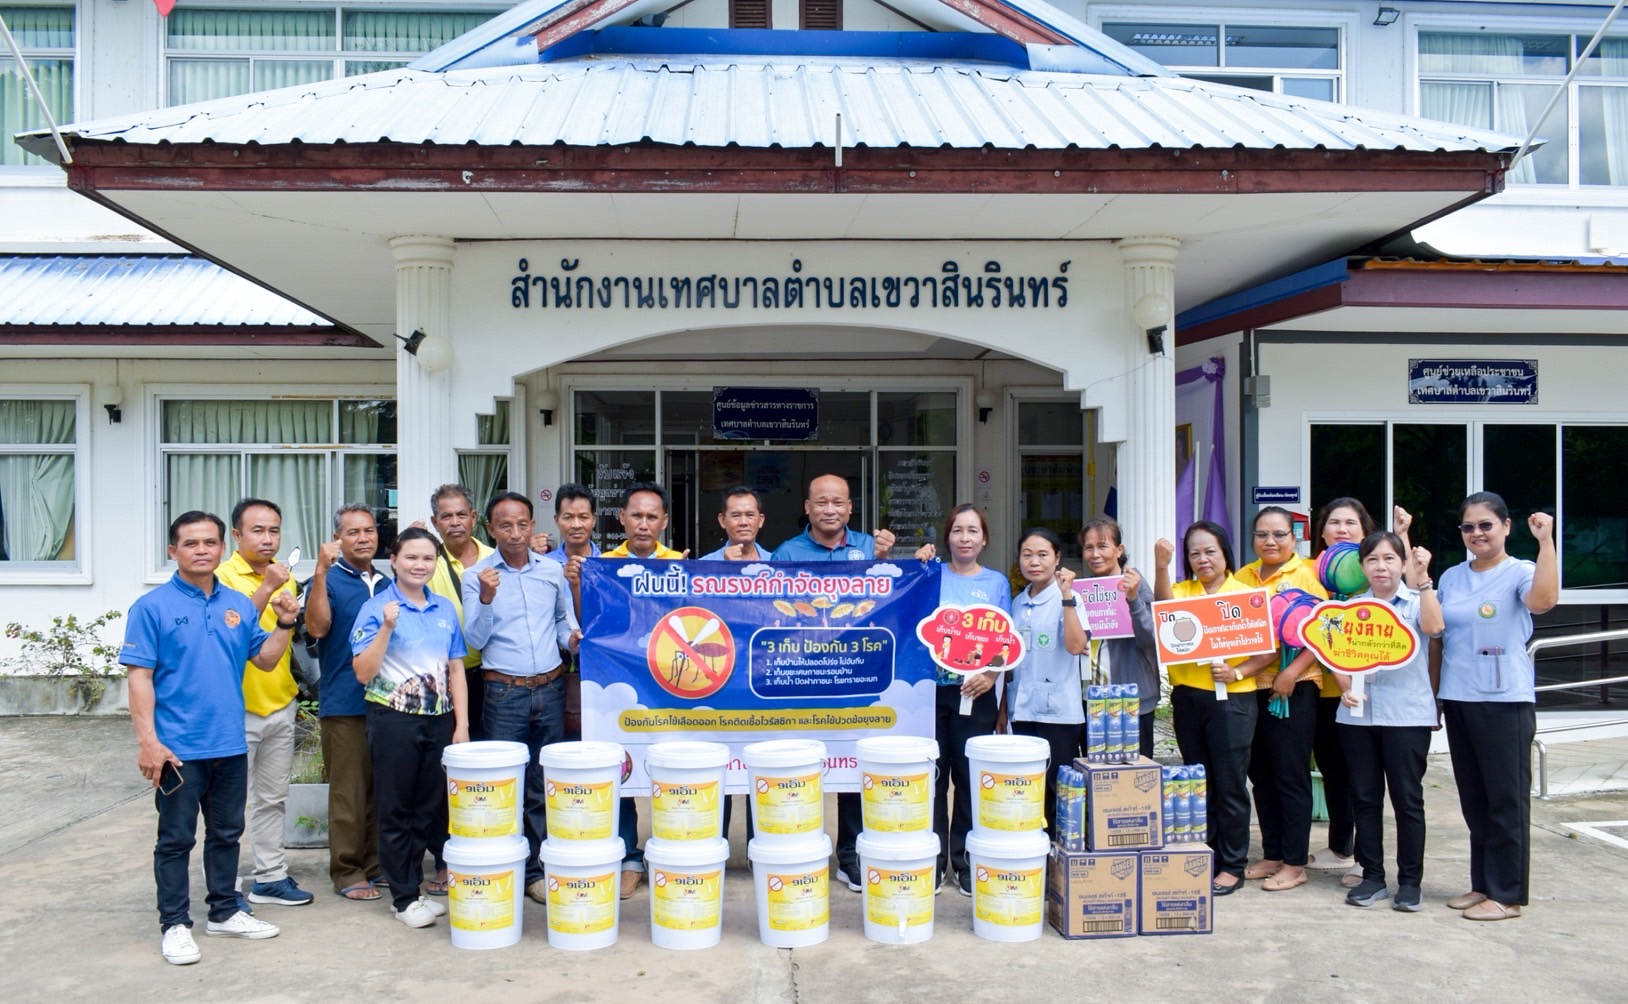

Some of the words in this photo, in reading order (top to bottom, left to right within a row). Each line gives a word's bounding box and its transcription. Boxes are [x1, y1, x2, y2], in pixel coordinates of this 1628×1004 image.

[510, 258, 1071, 309] สำนักงานเทศบาลตำบลเขวาสินรินทร์
[1422, 365, 1524, 380] ศูนย์ช่วยเหลือประชาชน
[1417, 384, 1532, 396] เทศบาลตำบลเขวาสินรินทร์
[716, 399, 814, 412] ศูนย์ข้อมูลข่าวสารทางราชการ
[720, 419, 810, 429] เทศบาลตำบลเขวาสินรินทร์
[634, 565, 687, 593] ฝนนี้!
[693, 572, 890, 600] รณรงค์กำจัดยุงลาย
[1217, 601, 1241, 619] ปิด
[961, 612, 974, 628] 3
[977, 611, 1007, 633] เก็บ
[1343, 621, 1394, 645] ยุงลาย
[761, 640, 775, 653] "3
[779, 638, 800, 653] เก็บ
[803, 638, 847, 653] ป้องกัน
[851, 641, 859, 653] 3
[862, 637, 888, 652] โรค"
[766, 678, 772, 686] 3.
[624, 715, 717, 727] ป้องกันโรคไข้เลือดออก
[719, 714, 796, 726] โรคติดเชื้อไวรัสซิกา
[798, 714, 892, 726] และโรคไข้ปวดข้อยุงลาย
